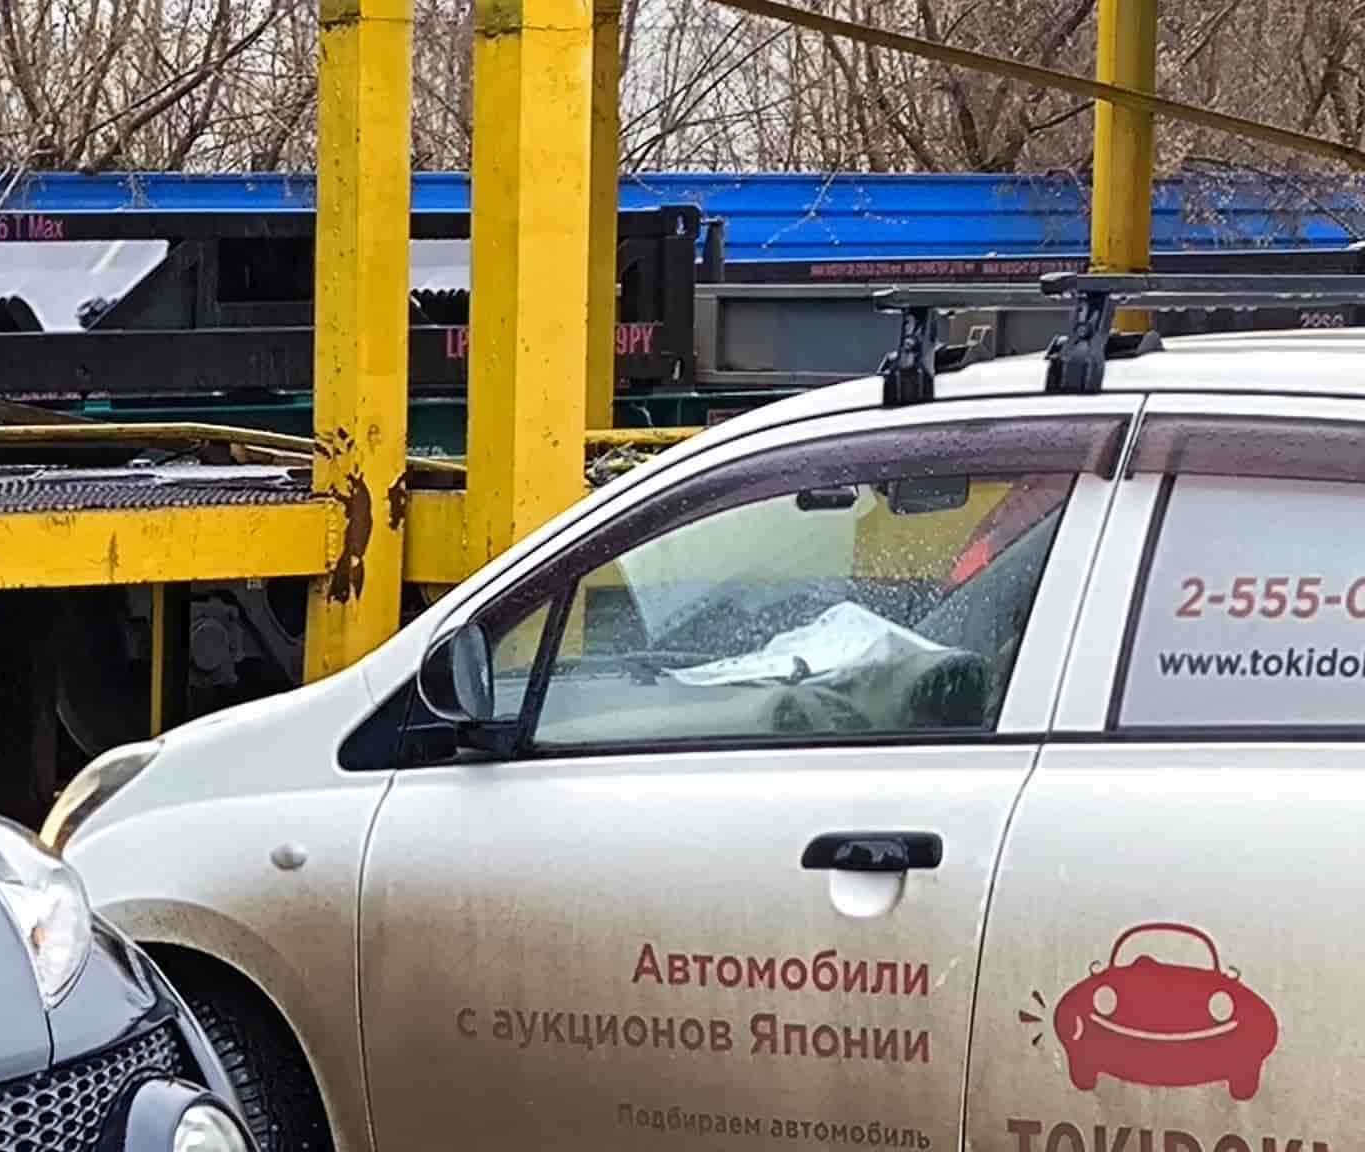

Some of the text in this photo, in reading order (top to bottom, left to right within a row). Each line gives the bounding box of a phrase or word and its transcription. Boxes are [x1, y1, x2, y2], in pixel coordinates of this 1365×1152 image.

[631, 943, 929, 997] Автомобили
[492, 1008, 734, 1053] аукционов
[749, 1013, 930, 1064] Японии
[617, 1102, 931, 1151] Подбираем автомобиль
